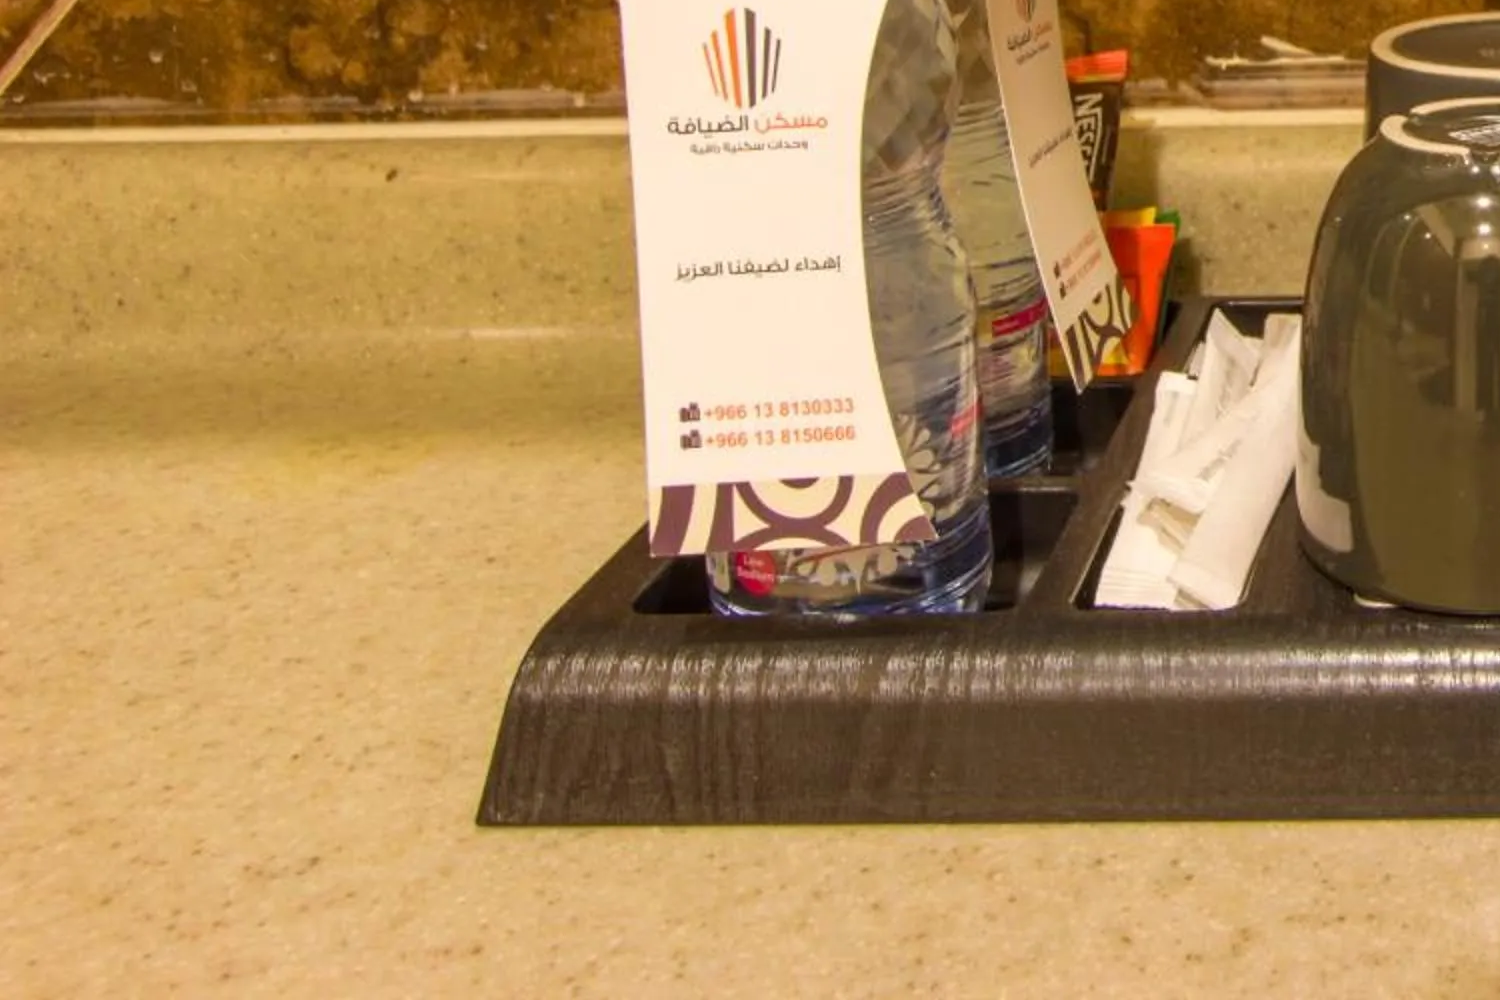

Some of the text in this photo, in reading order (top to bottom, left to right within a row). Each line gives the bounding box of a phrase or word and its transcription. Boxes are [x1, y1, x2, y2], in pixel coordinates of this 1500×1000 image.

[666, 111, 828, 138] مسكن الضيافة
[766, 140, 809, 151] وحدات
[1073, 93, 1103, 182] NESC
[676, 261, 723, 282] العزيز
[727, 258, 789, 278] لضيفنا
[704, 397, 855, 421] +966 13 8130333
[705, 425, 856, 448] +966 13 8150666
